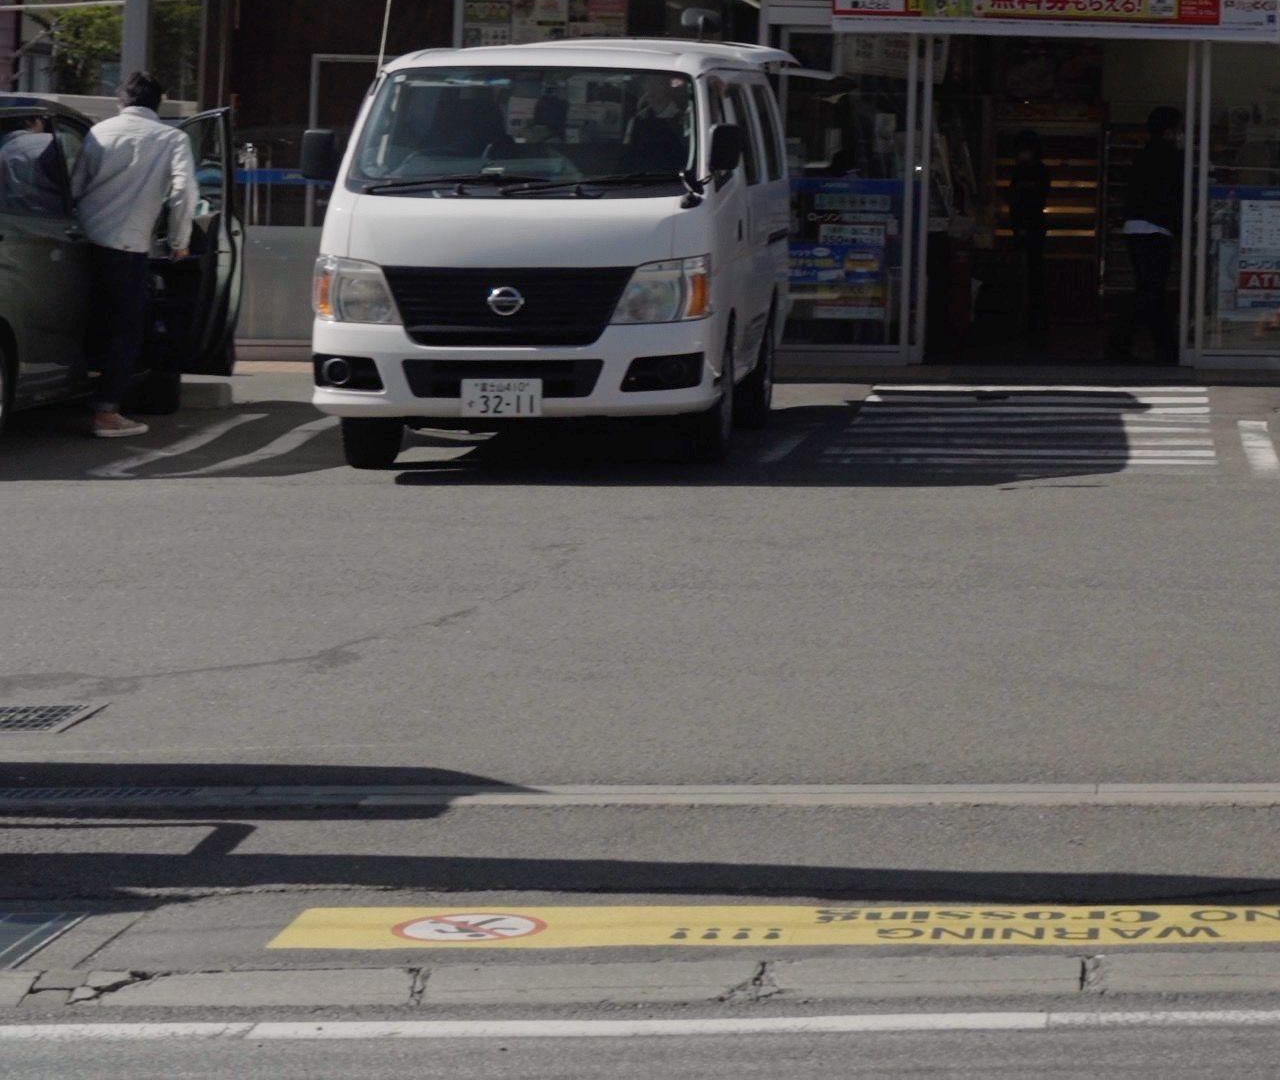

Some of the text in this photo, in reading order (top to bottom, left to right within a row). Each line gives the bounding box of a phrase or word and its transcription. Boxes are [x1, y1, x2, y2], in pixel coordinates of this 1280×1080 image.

[479, 394, 534, 414] 32-11
[816, 908, 1161, 923] Crossing
[877, 925, 1222, 940] WARNING
